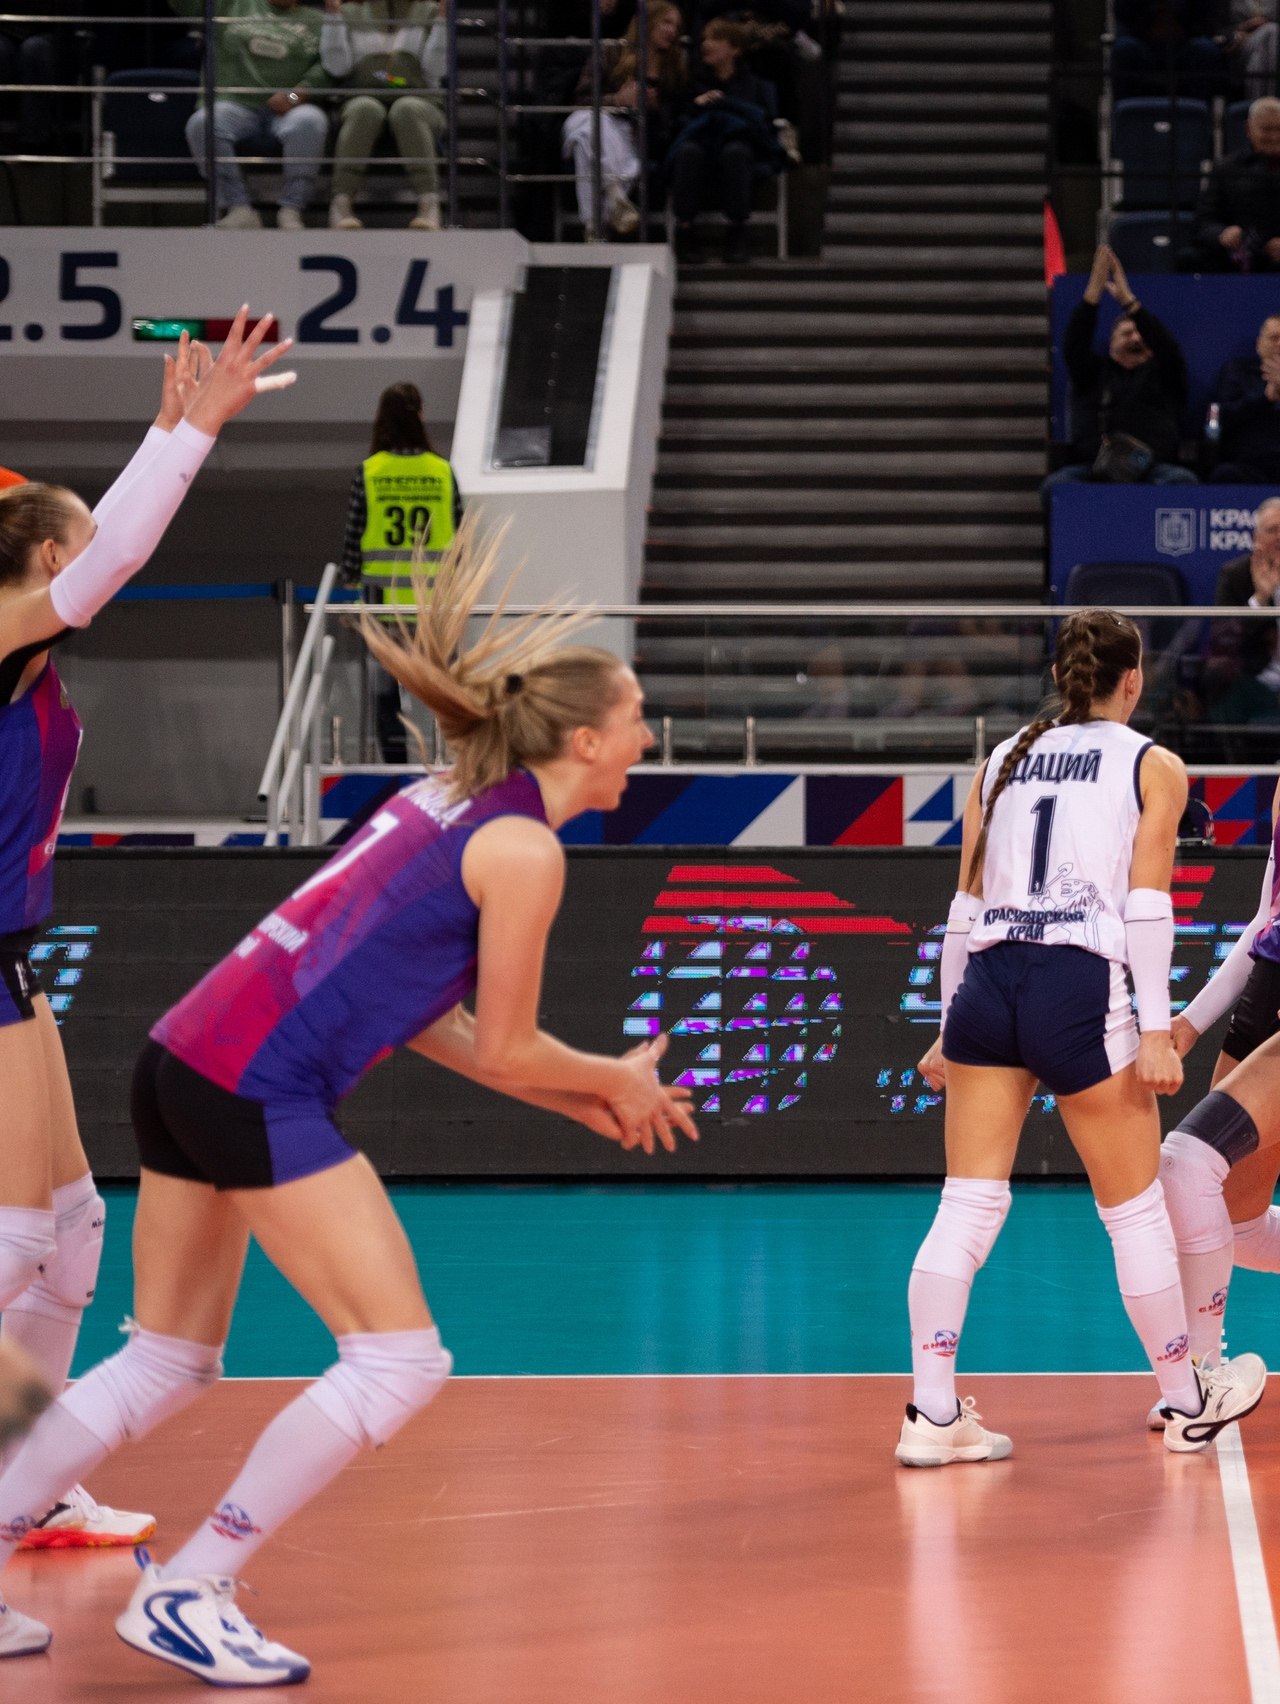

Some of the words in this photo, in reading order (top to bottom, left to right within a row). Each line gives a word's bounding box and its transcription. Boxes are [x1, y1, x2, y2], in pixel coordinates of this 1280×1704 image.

[0, 252, 122, 341] .5
[297, 255, 468, 347] 2.4
[384, 506, 432, 547] 39
[1210, 531, 1254, 551] КРА
[1028, 795, 1057, 895] 1
